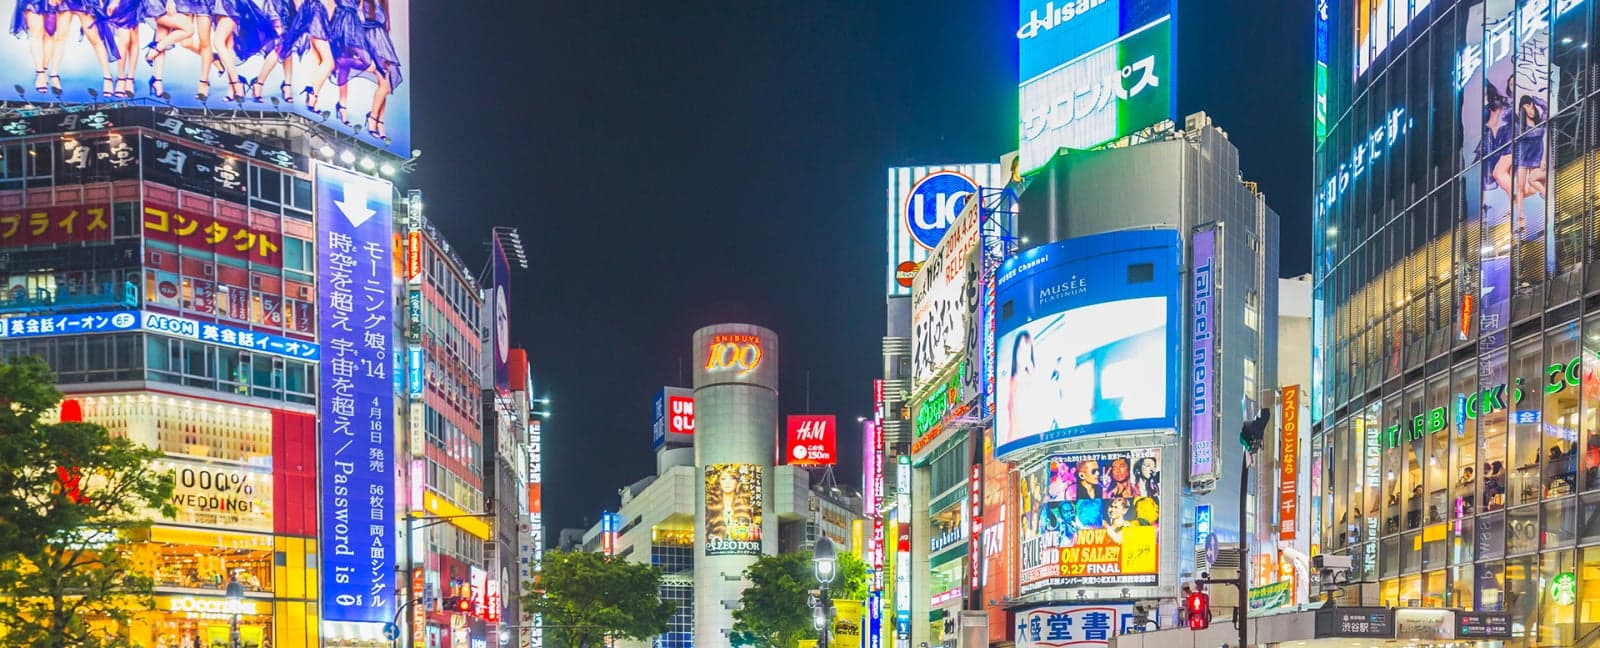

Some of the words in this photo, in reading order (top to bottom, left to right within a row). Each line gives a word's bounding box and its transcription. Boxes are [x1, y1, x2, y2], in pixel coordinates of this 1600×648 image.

[1020, 54, 1160, 142] サロンパス
[144, 206, 279, 258] コンタクト
[1018, 254, 1049, 273] Channel
[329, 231, 354, 332] 時空を超え
[1040, 287, 1087, 305] PLATINUM
[1194, 256, 1211, 341] Taisei
[11, 316, 109, 335] 英会話イーオン
[147, 315, 194, 335] AEON
[203, 325, 316, 357] 英会話イーオン
[715, 335, 761, 344] SHIBUYA
[704, 342, 764, 378] 109
[1194, 347, 1208, 416] neon
[672, 401, 693, 416] UN
[796, 420, 827, 441] H&M
[1283, 388, 1296, 475] クスリのことなら
[368, 447, 385, 473] 発売
[807, 451, 831, 459] 150m
[172, 494, 253, 513] WEDDING!
[333, 460, 355, 556] Password
[369, 484, 384, 521] 56枚目
[1281, 480, 1296, 533] 三千里
[1077, 529, 1107, 546] NOW
[1061, 547, 1080, 564] ON
[1081, 546, 1121, 564] SALE!!
[335, 566, 355, 585] is
[369, 524, 386, 609] 両A面シングル
[1060, 563, 1086, 576] 9.27
[1086, 563, 1121, 574] FINAL
[1341, 622, 1369, 633] 渋谷駅
